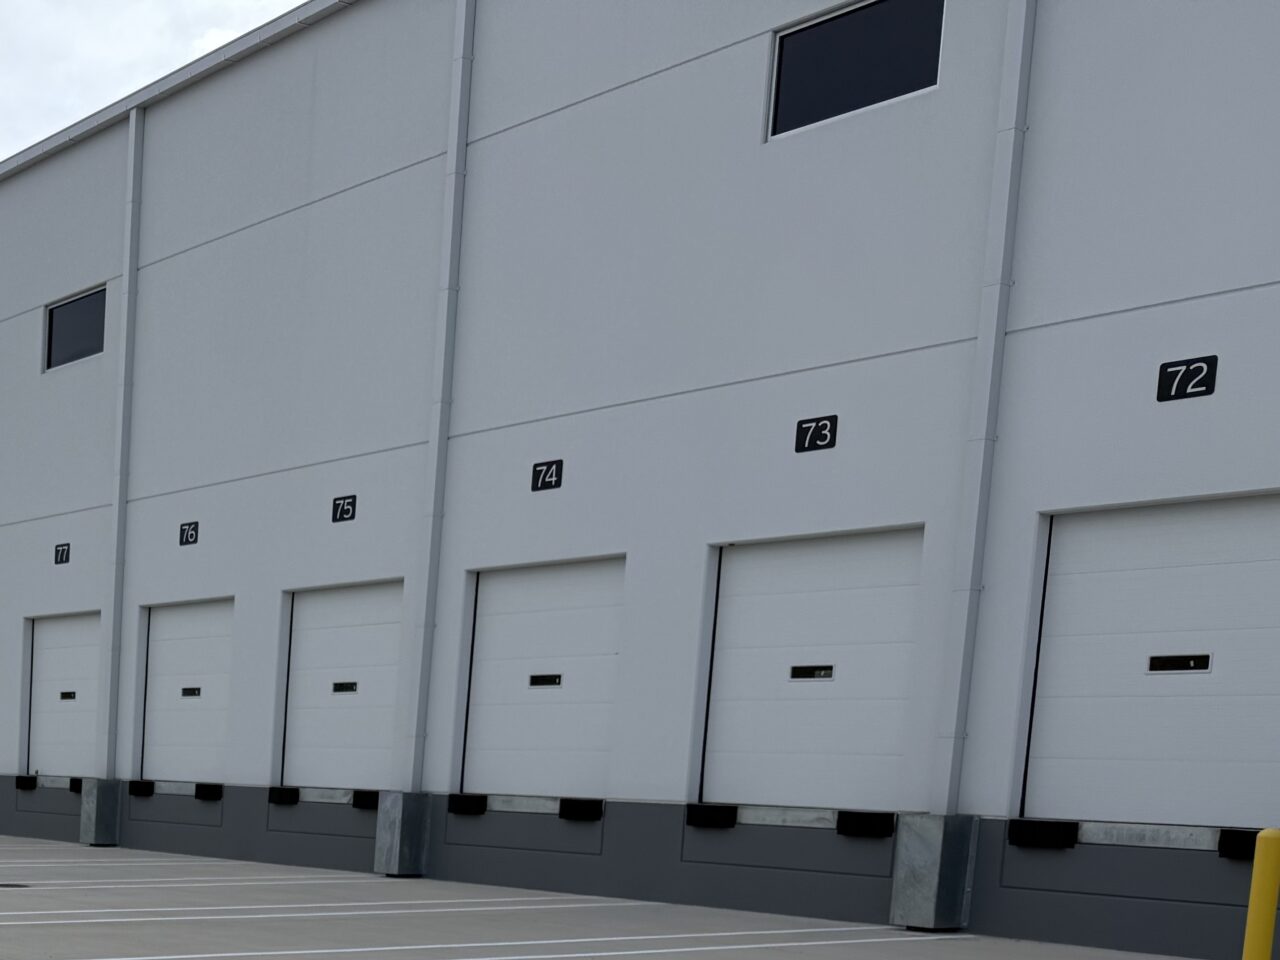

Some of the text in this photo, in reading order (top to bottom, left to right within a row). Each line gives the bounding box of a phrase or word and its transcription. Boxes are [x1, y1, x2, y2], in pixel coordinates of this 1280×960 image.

[1166, 362, 1208, 396] 72
[801, 420, 831, 447] 73
[535, 464, 558, 488] 74
[335, 498, 353, 519] 75
[181, 524, 196, 543] 76
[56, 545, 68, 562] 77
